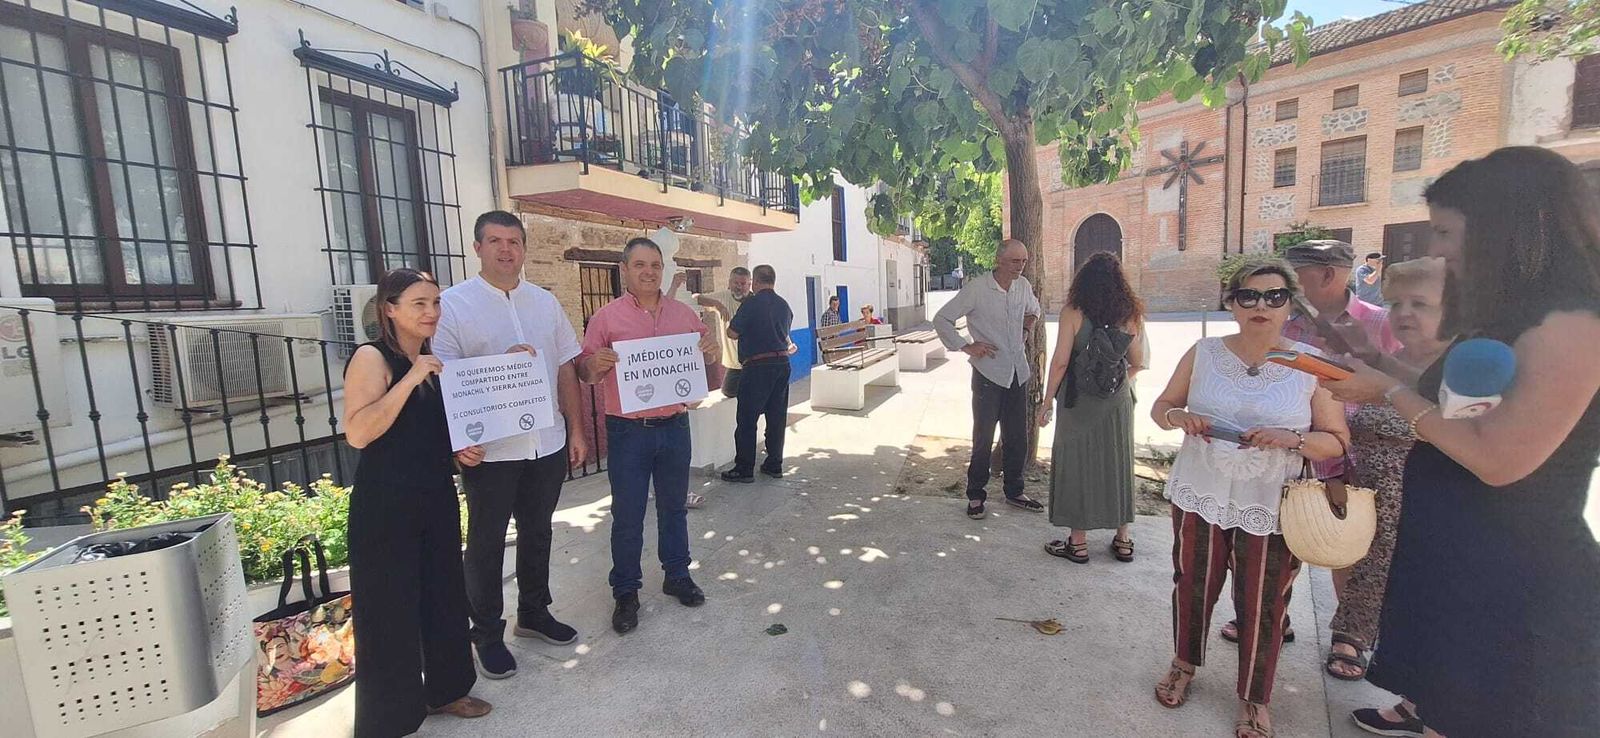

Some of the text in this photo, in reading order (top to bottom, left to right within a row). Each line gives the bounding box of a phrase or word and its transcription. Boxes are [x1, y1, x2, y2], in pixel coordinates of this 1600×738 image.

[1, 345, 33, 360] LG
[627, 346, 693, 366] ¡MÉDICO YA!
[467, 365, 505, 376] QUEREMOS
[507, 361, 533, 371] MÉDICO
[624, 361, 700, 381] EN MONACHIL
[452, 388, 485, 399] MONACHIL
[491, 383, 517, 392] SIERRA
[518, 378, 544, 388] NEVADA
[461, 371, 528, 387] COMPARTIDO ENTRE
[459, 402, 507, 418] CONSULTORIOS
[508, 396, 547, 408] COMPLETOS
